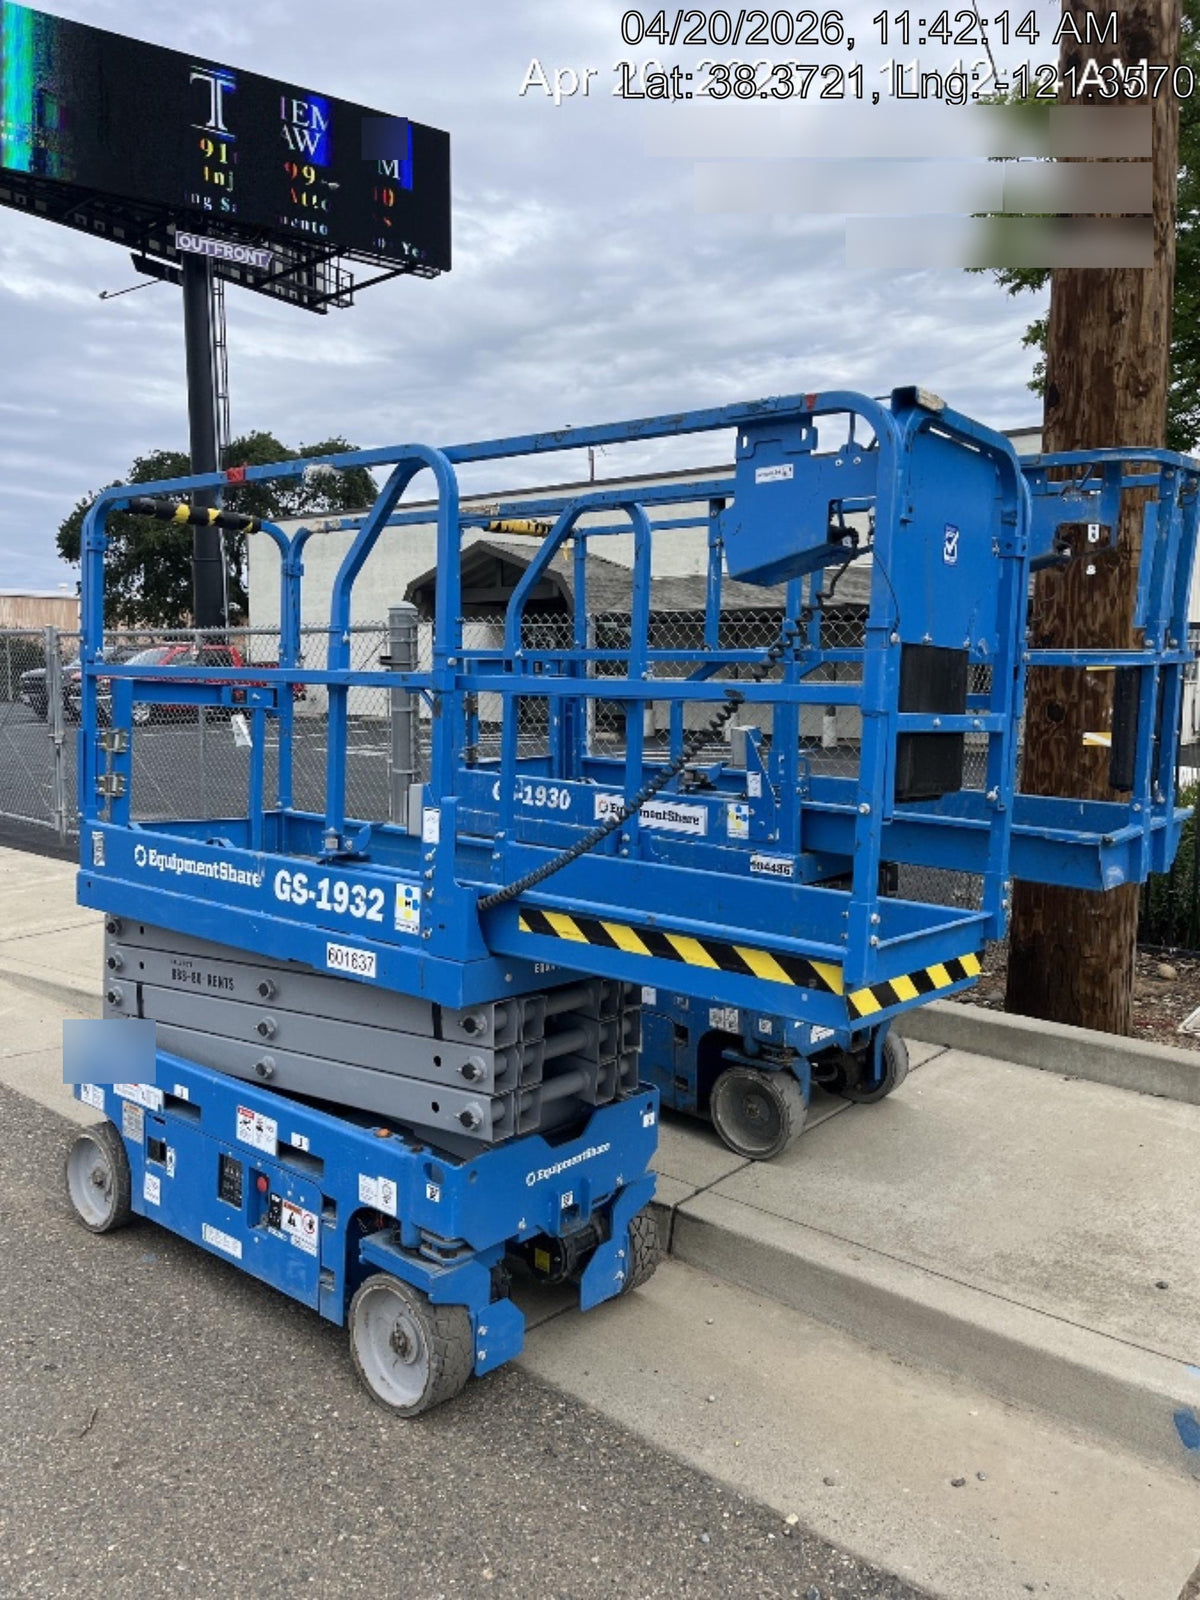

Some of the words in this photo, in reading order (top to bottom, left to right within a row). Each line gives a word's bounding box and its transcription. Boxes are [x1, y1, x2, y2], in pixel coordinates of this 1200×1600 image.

[180, 235, 266, 267] OUTFRONT
[149, 849, 263, 888] EquipmentShare
[274, 868, 386, 923] GS-1932
[328, 947, 375, 973] 601637
